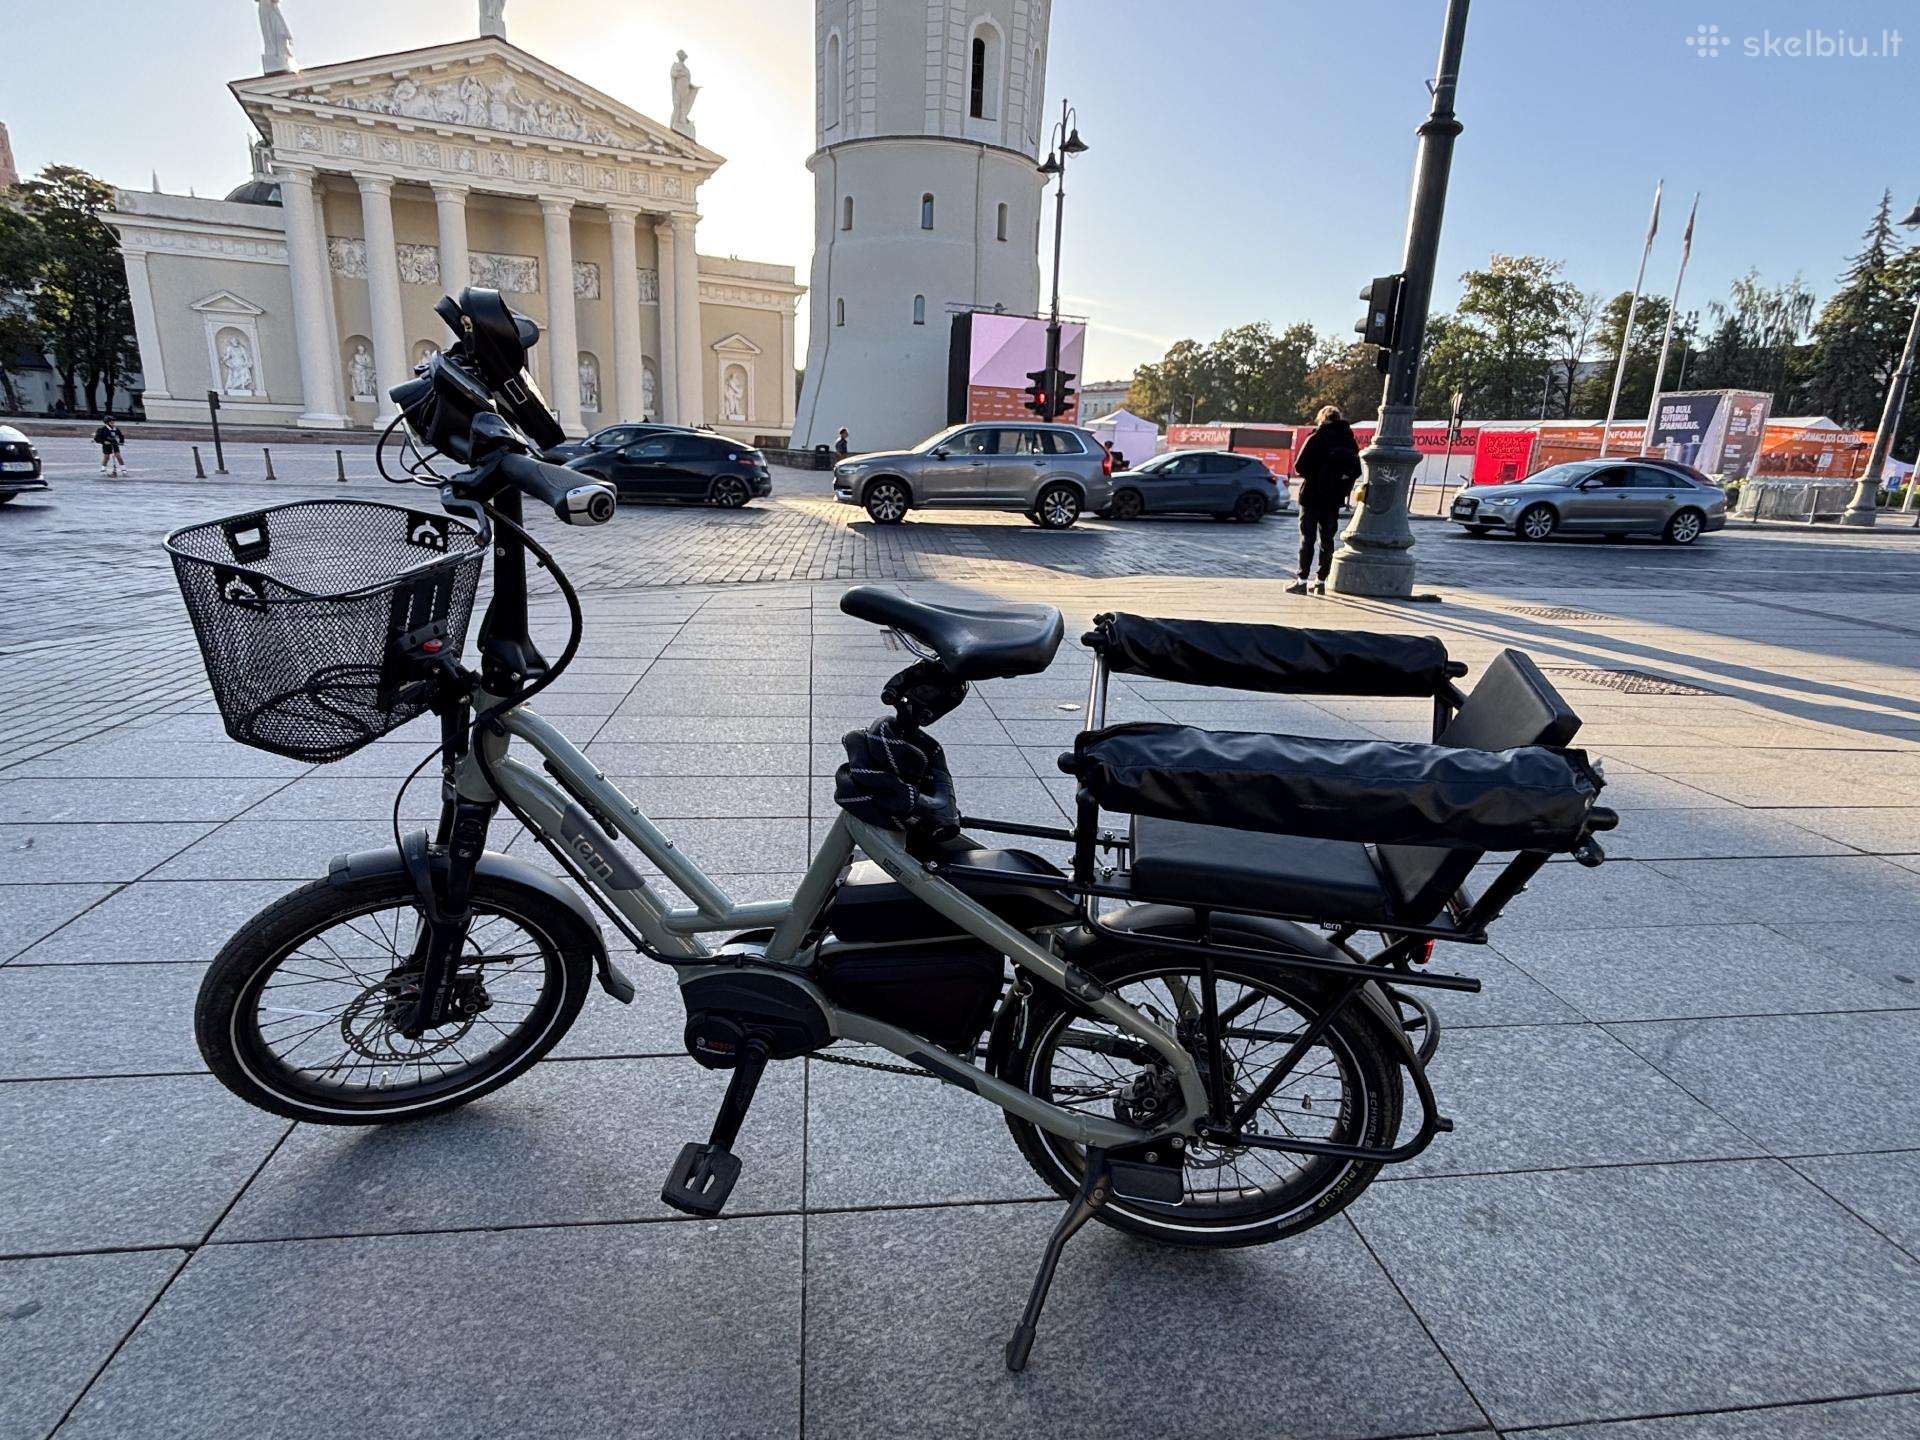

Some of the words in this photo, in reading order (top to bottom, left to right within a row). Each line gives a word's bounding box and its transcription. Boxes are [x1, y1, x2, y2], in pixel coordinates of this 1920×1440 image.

[1662, 405, 1675, 414] RED
[1675, 404, 1692, 414] BULL
[572, 832, 614, 879] tern
[1341, 1086, 1353, 1132] ATLAS
[1364, 1090, 1379, 1149] SCHWALB
[1317, 1168, 1358, 1209] PICK-UP
